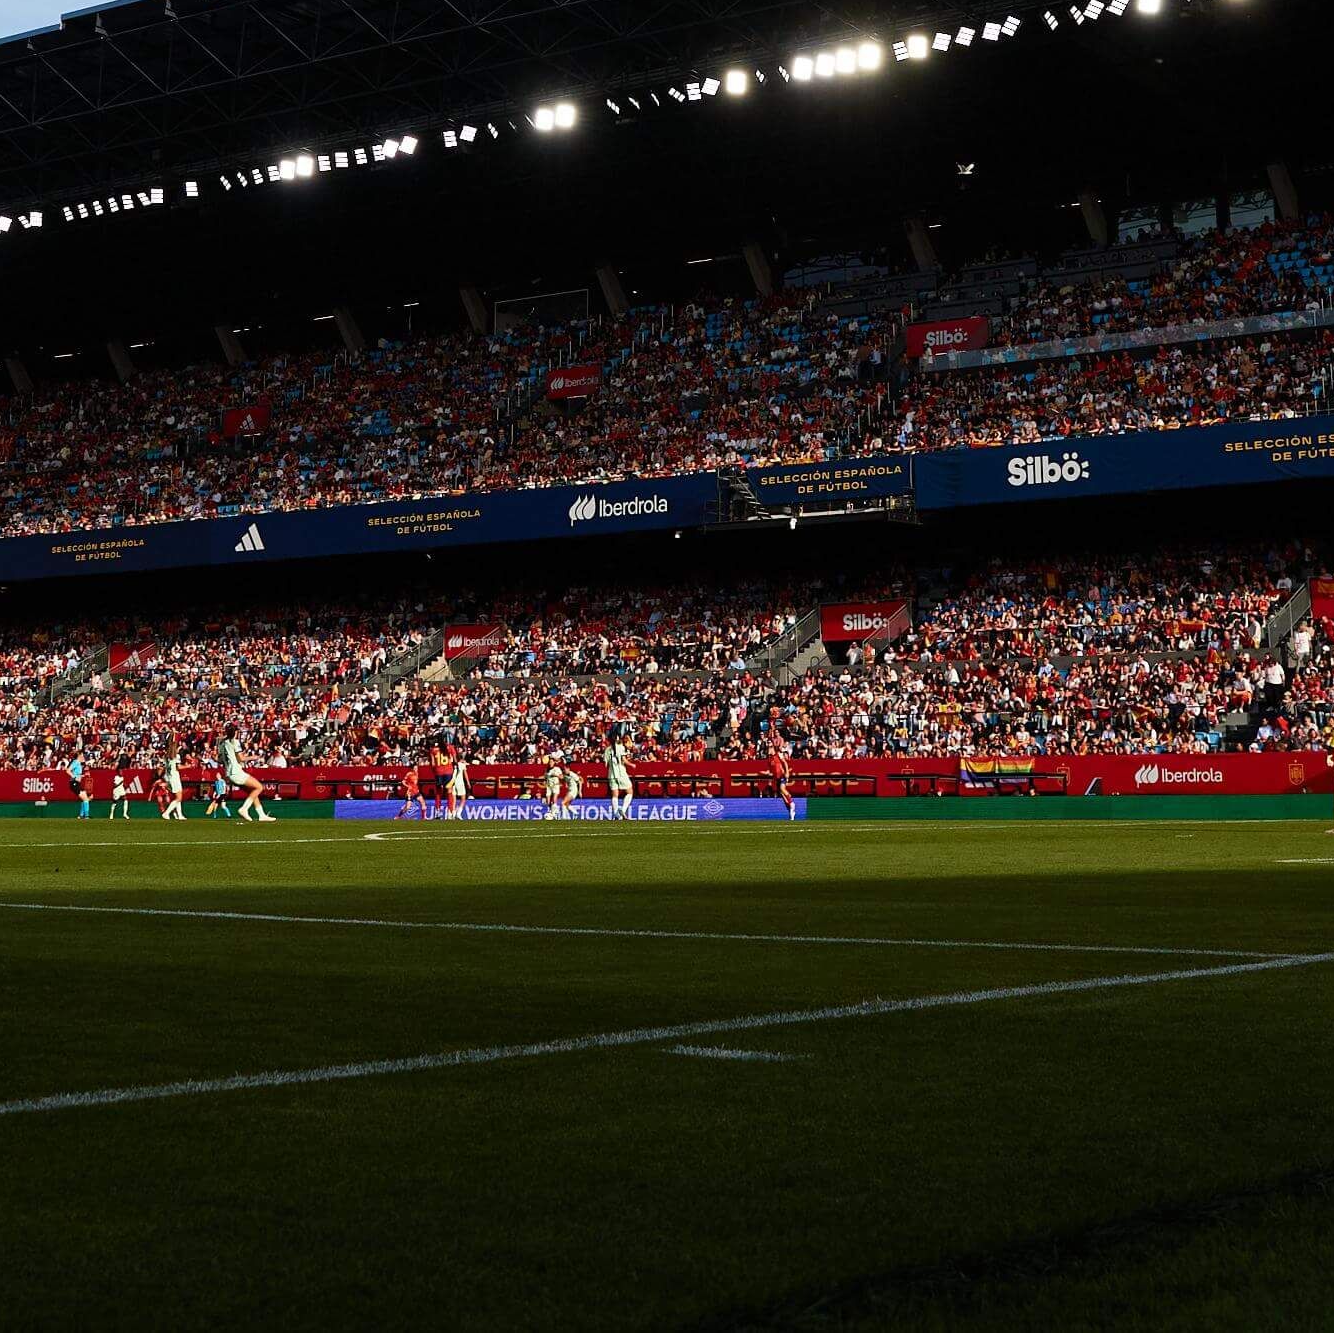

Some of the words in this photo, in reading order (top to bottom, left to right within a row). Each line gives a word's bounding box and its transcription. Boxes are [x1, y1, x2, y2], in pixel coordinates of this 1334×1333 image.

[1224, 434, 1312, 452] SELECCIÓN
[1272, 451, 1292, 462] DE
[760, 470, 830, 486] SELECCIÓN
[834, 465, 902, 479] ESPAÑOLA
[1007, 451, 1081, 487] Silbö
[797, 485, 814, 494] DE
[818, 481, 868, 492] FÚTBOL
[599, 494, 668, 518] Iberdrola
[367, 513, 424, 526] SELECCIÓN
[426, 509, 481, 521] ESPAÑOLA
[396, 526, 411, 534] DE
[413, 523, 453, 533] FÚTBOL
[75, 554, 87, 562] DE
[1161, 767, 1223, 783] Iberdrola
[466, 805, 543, 820] WOMEN'S
[628, 805, 697, 820] LEAGUE
